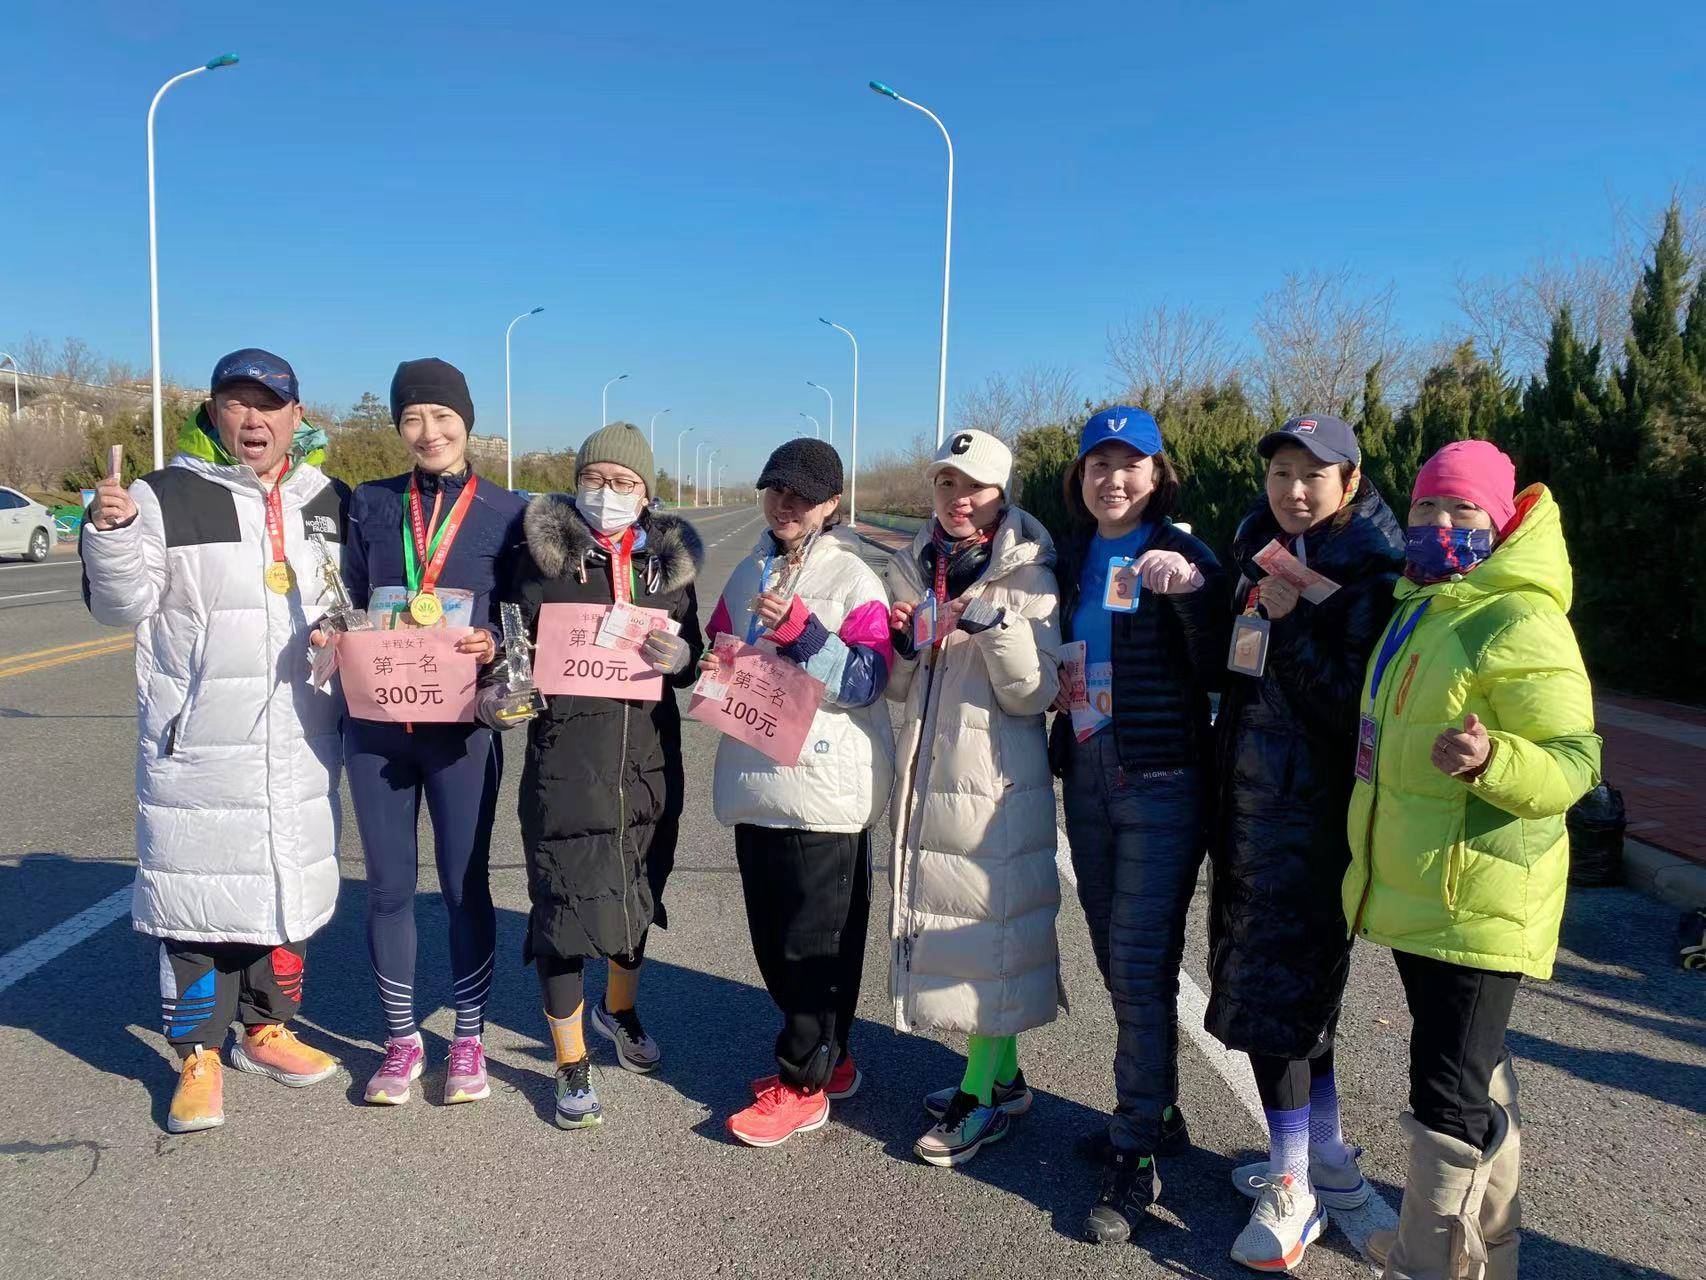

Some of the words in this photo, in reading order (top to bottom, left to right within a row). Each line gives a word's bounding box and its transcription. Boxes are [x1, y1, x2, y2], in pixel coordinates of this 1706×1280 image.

[951, 434, 973, 454] C
[380, 637, 425, 650] 半程女子
[373, 653, 438, 676] 第一名
[563, 658, 629, 681] 200元
[374, 683, 444, 706] 300元
[733, 669, 787, 709] 第三名
[720, 696, 779, 738] 100元
